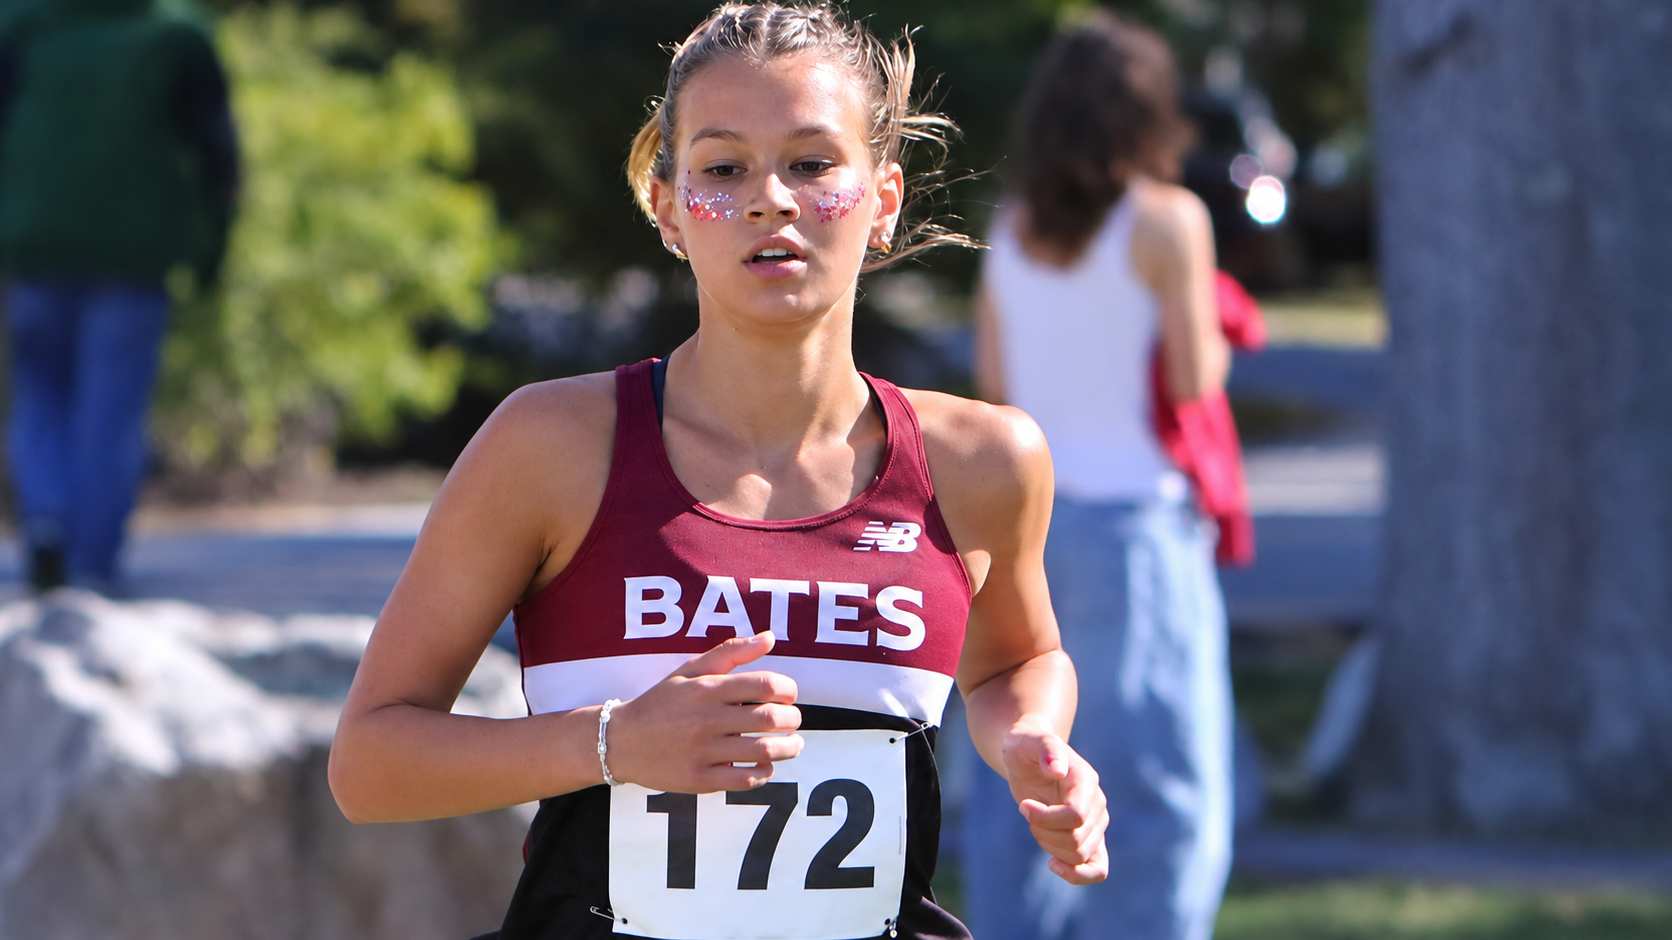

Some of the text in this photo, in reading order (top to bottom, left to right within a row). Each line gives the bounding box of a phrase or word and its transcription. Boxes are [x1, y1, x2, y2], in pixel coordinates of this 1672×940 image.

[853, 521, 922, 553] NB
[623, 575, 926, 651] BATES
[646, 779, 875, 890] 172
